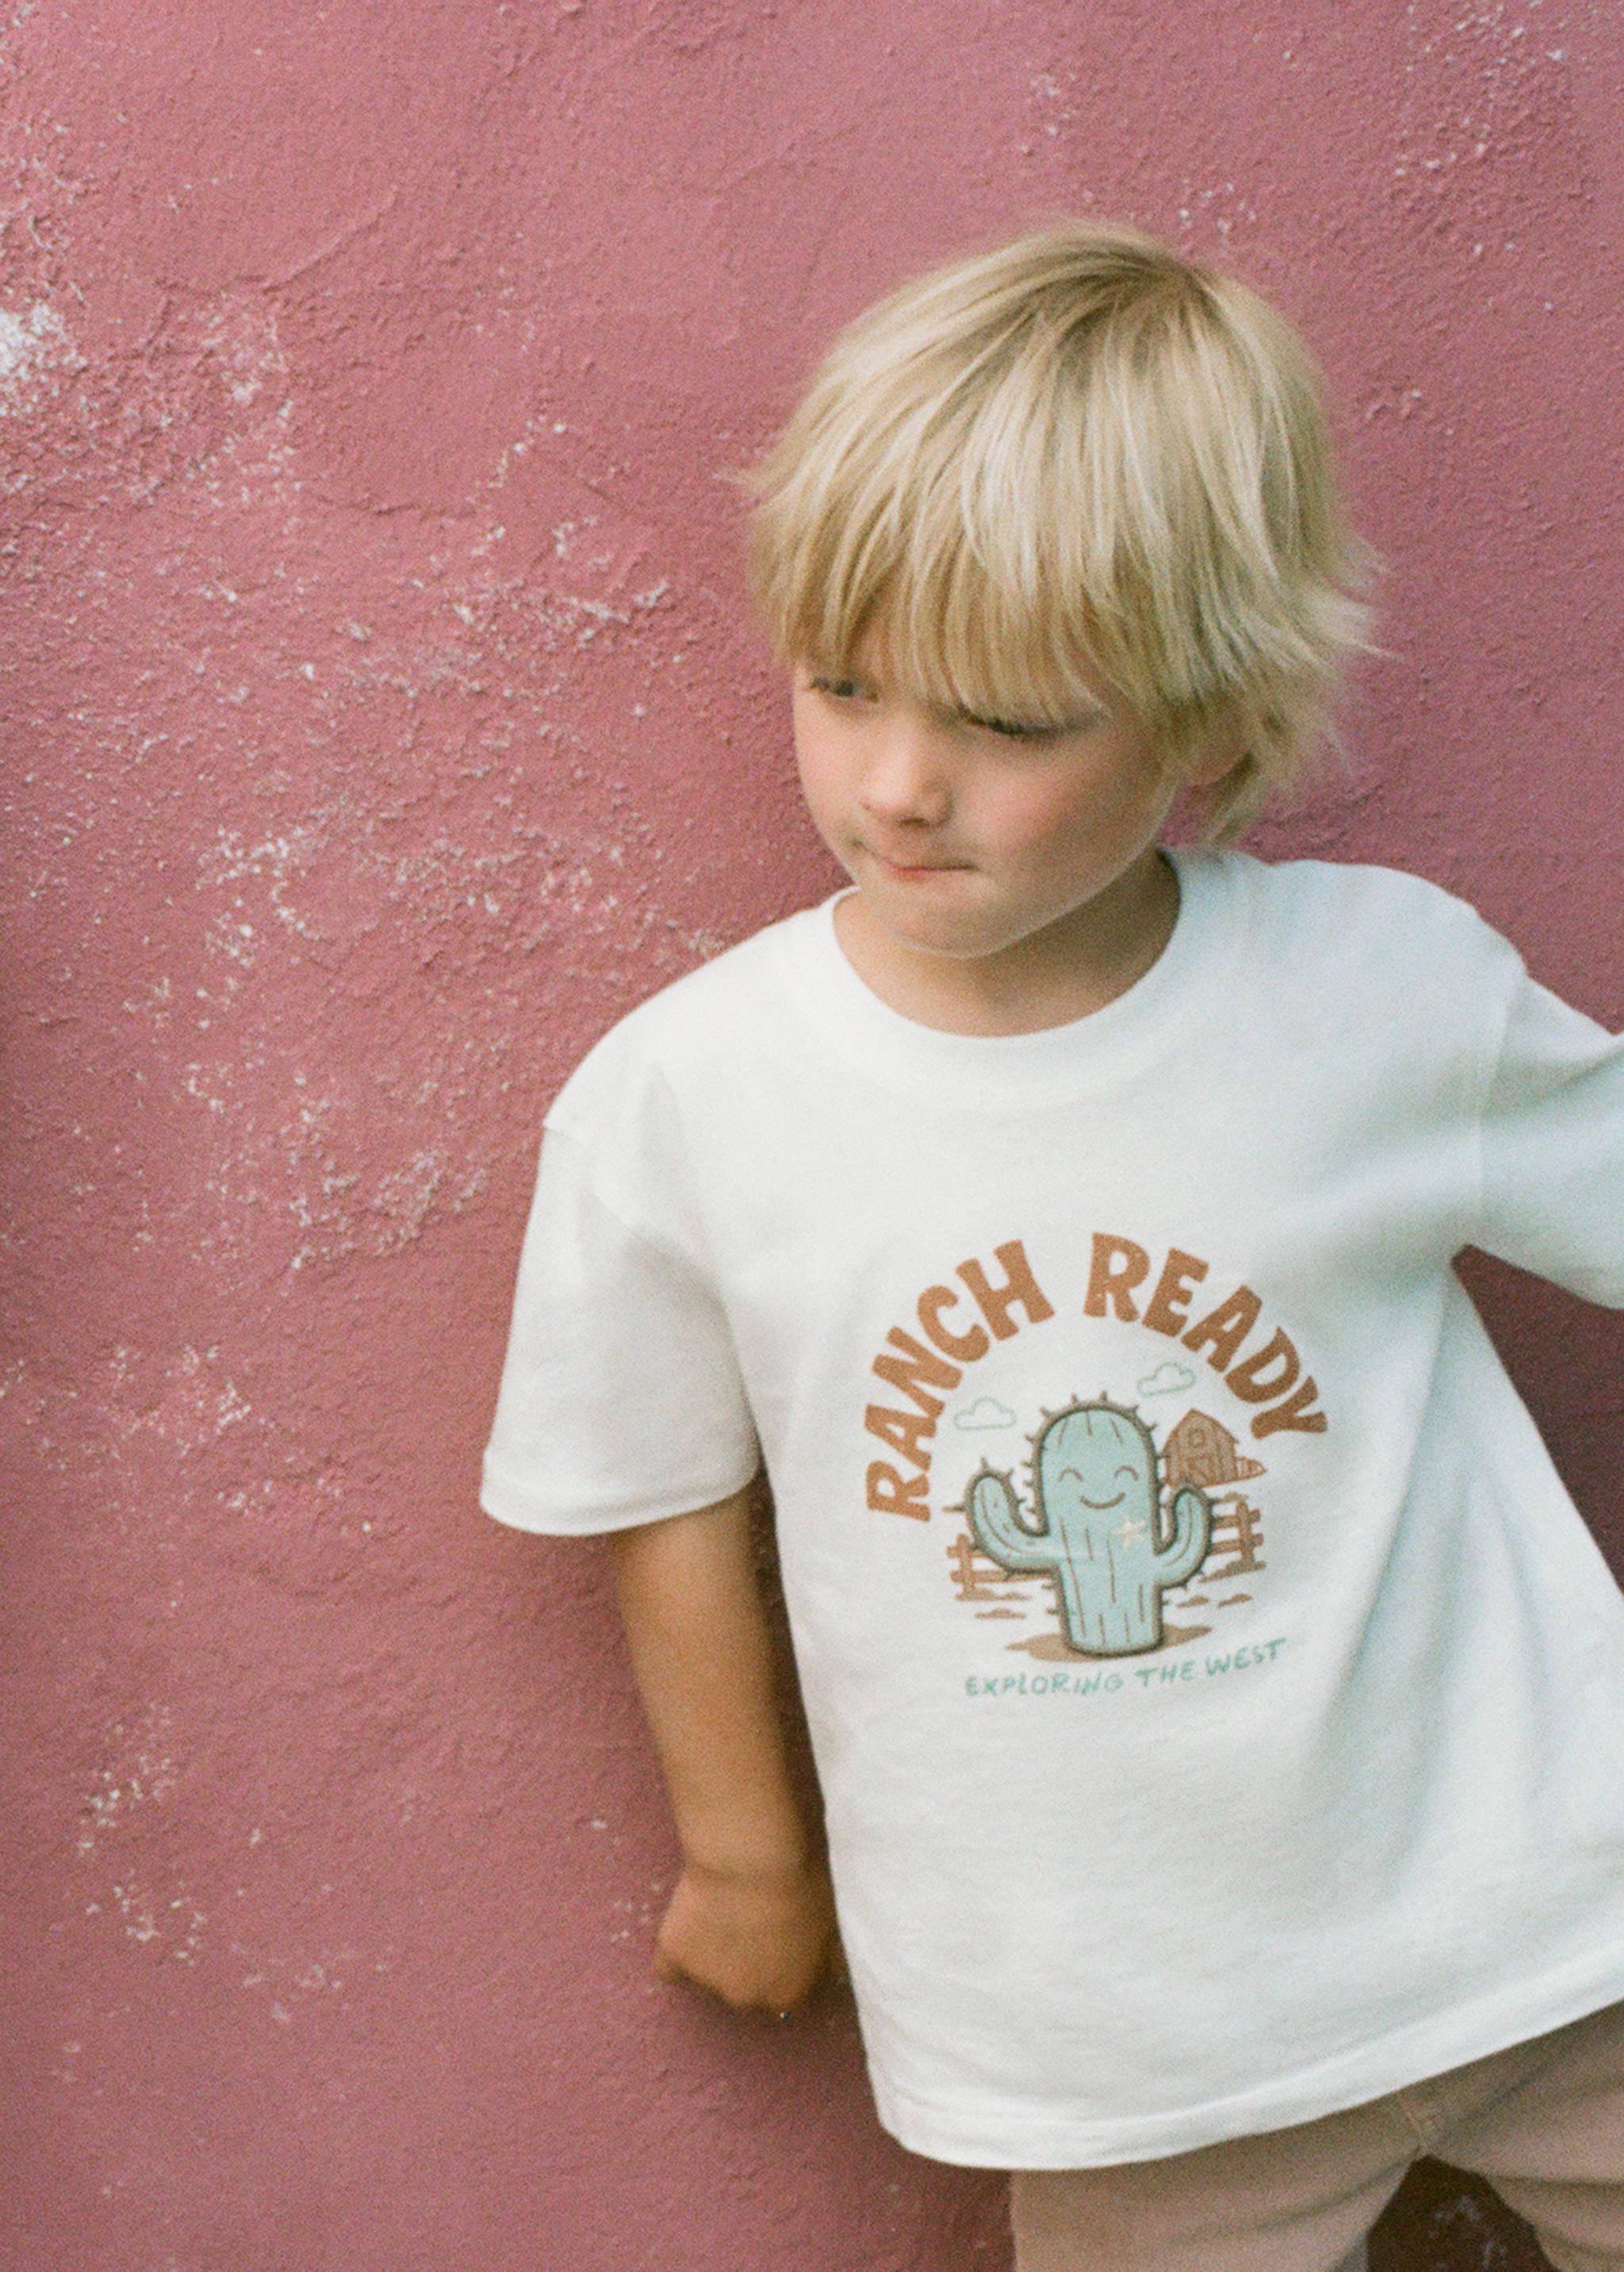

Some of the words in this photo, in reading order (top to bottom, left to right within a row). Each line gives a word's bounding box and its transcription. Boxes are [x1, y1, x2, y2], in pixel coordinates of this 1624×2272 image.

[864, 1239, 1055, 1522] RANCH
[1083, 1232, 1328, 1440] READY
[964, 1671, 1125, 1697] EXPLORING
[1134, 1661, 1194, 1688] THE
[1205, 1637, 1287, 1677] WEST
